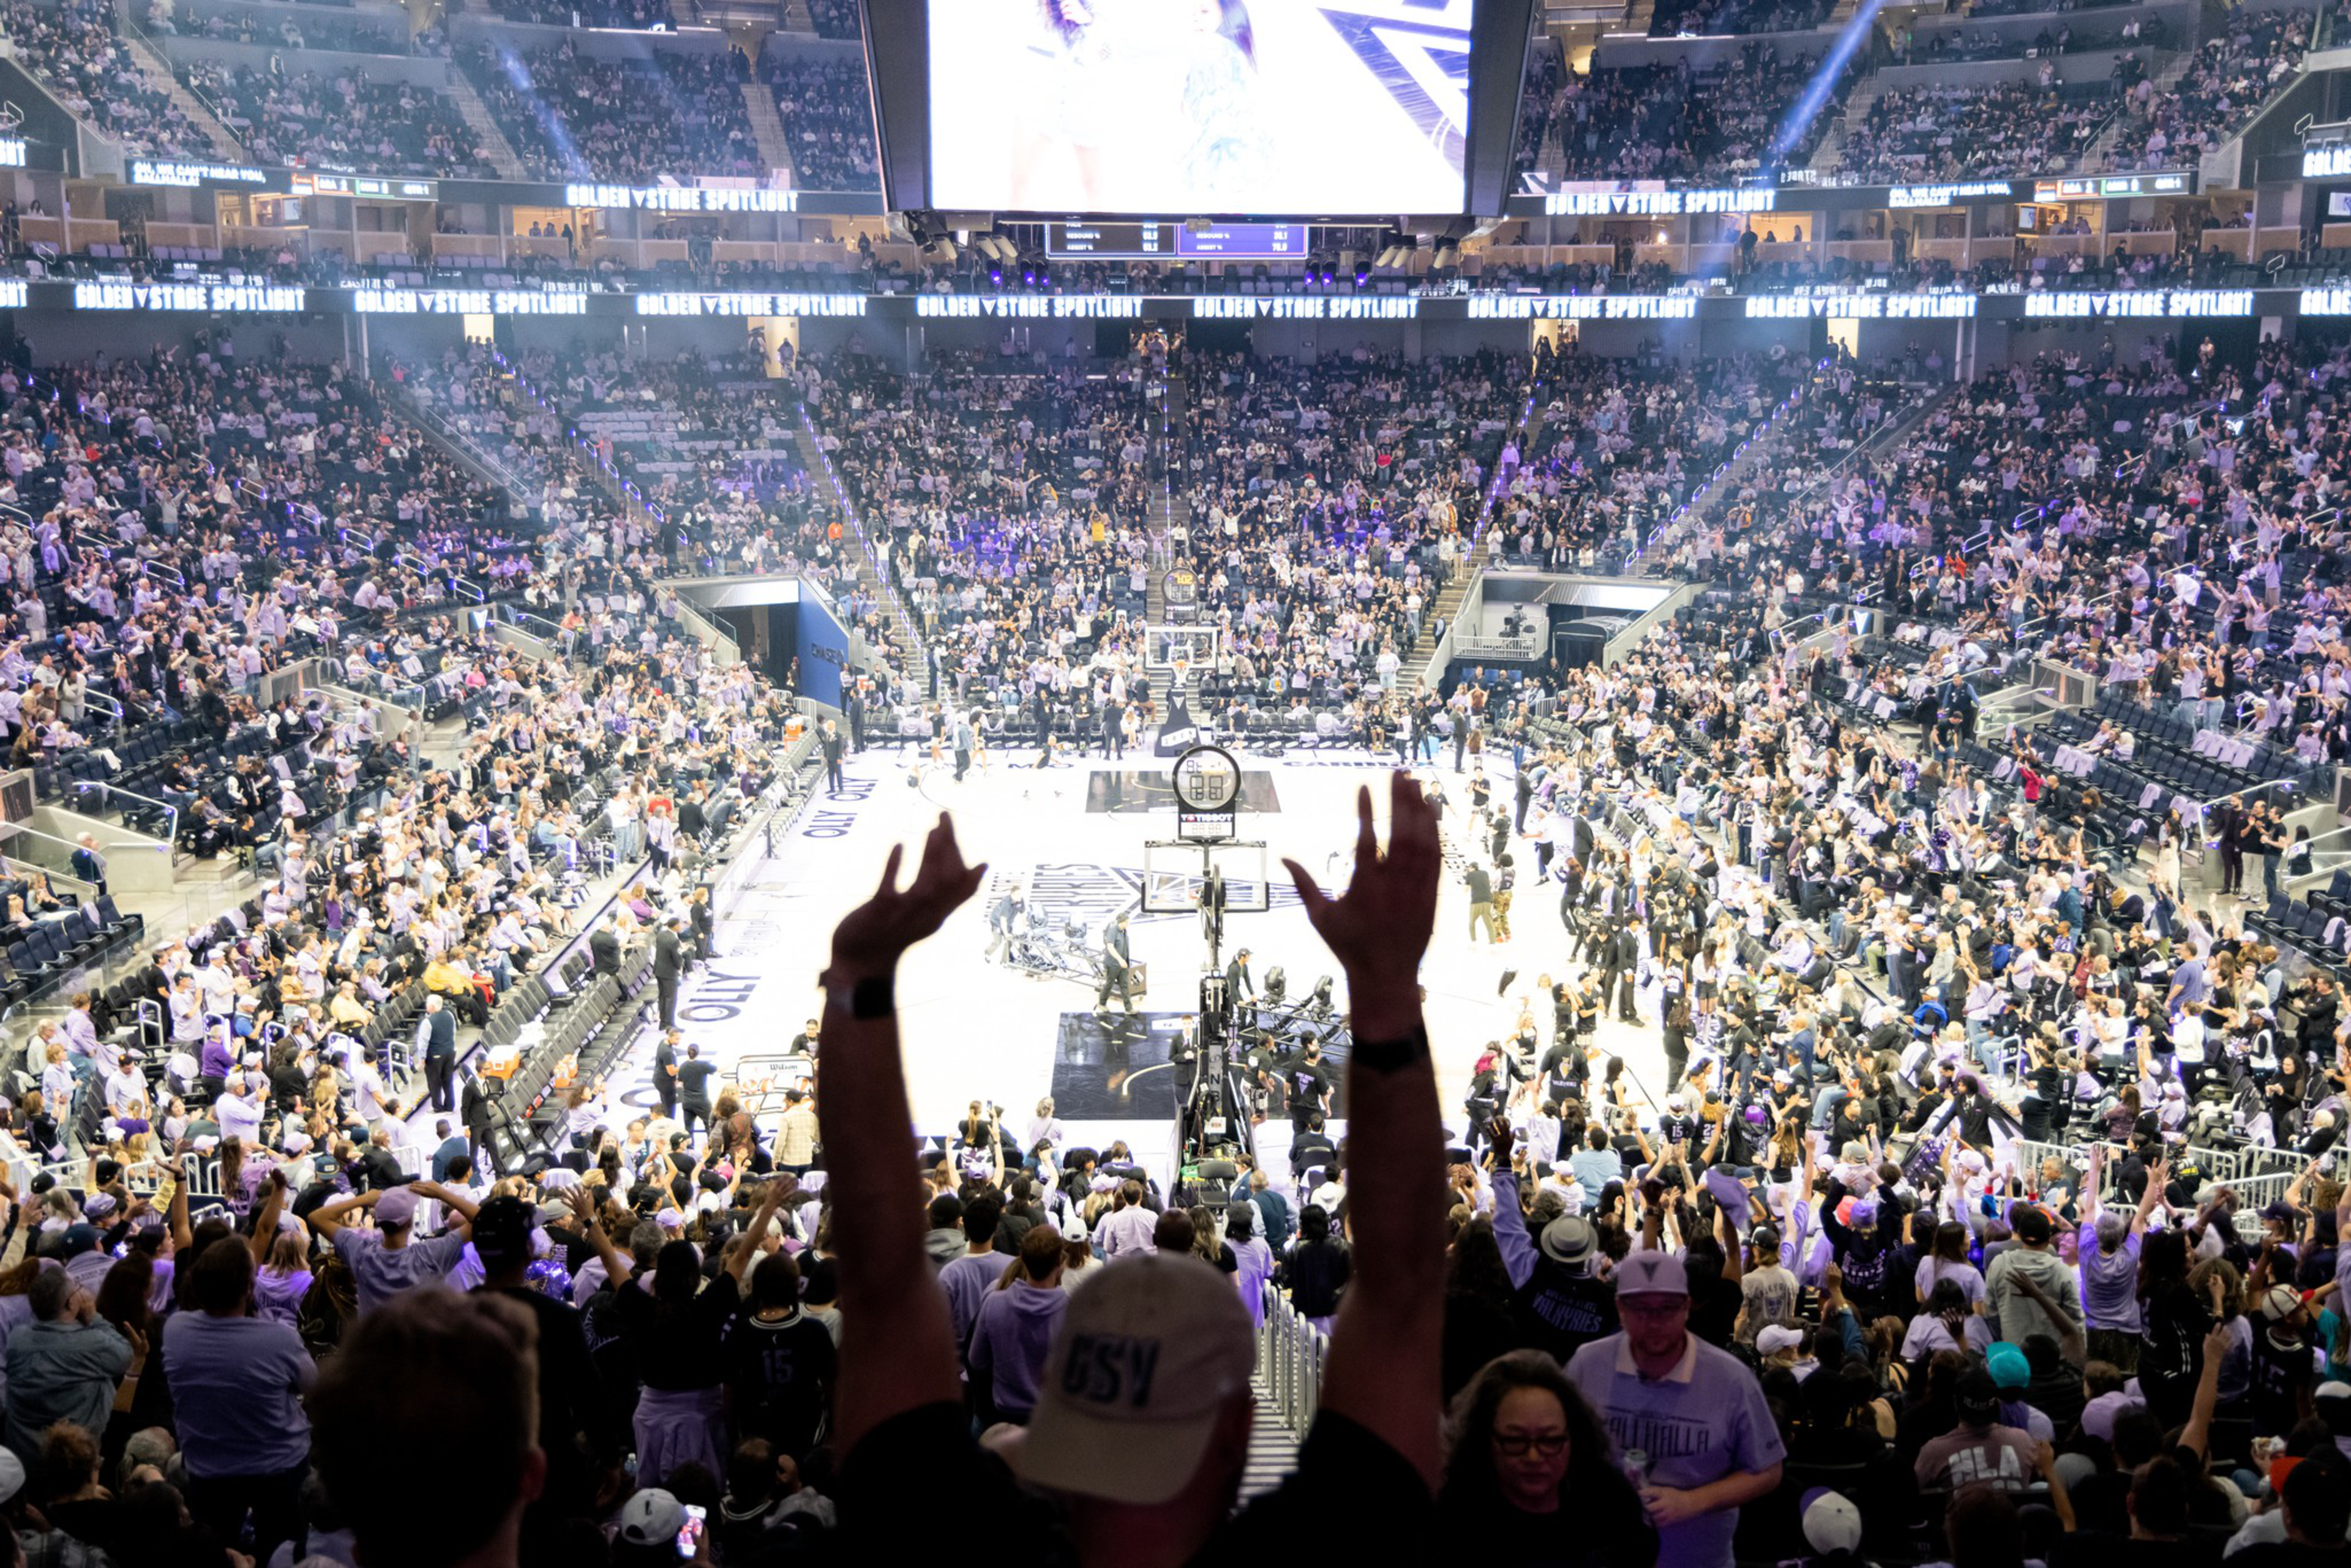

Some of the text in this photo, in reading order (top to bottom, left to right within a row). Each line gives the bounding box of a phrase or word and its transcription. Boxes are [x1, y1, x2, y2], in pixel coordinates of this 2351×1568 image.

[209, 167, 239, 180] HEAR
[566, 184, 797, 211] GOLDEN STAGE SPOTLIGHT
[1960, 184, 1986, 196] HEAR
[1545, 190, 1774, 215] GOLDEN STAGE SPOTLIGHT
[75, 284, 305, 311] GOLDEN STAGE SPOTLIGHT
[354, 291, 588, 313] GOLDEN STAGE SPOTLIGHT
[637, 295, 868, 316] GOLDEN STAGE SPOTLIGHT
[917, 298, 1142, 317] GOLDEN STAGE SPOTLIGHT
[1194, 298, 1418, 317] GOLDEN STAGE SPOTLIGHT
[1468, 298, 1696, 318] GOLDEN STAGE SPOTLIGHT
[1746, 296, 1978, 317] GOLDEN STAGE SPOTLIGHT
[2025, 293, 2254, 317] GOLDEN STAGE SPOTLIGHT
[803, 811, 858, 838] OLLY
[678, 971, 762, 1021] OLLY
[1672, 1125, 1684, 1138] 15
[1532, 1292, 1603, 1333] VALKYRIES
[762, 1349, 793, 1384] 15
[1062, 1333, 1160, 1408] GSV
[1610, 1416, 1709, 1458] ALLHALLA
